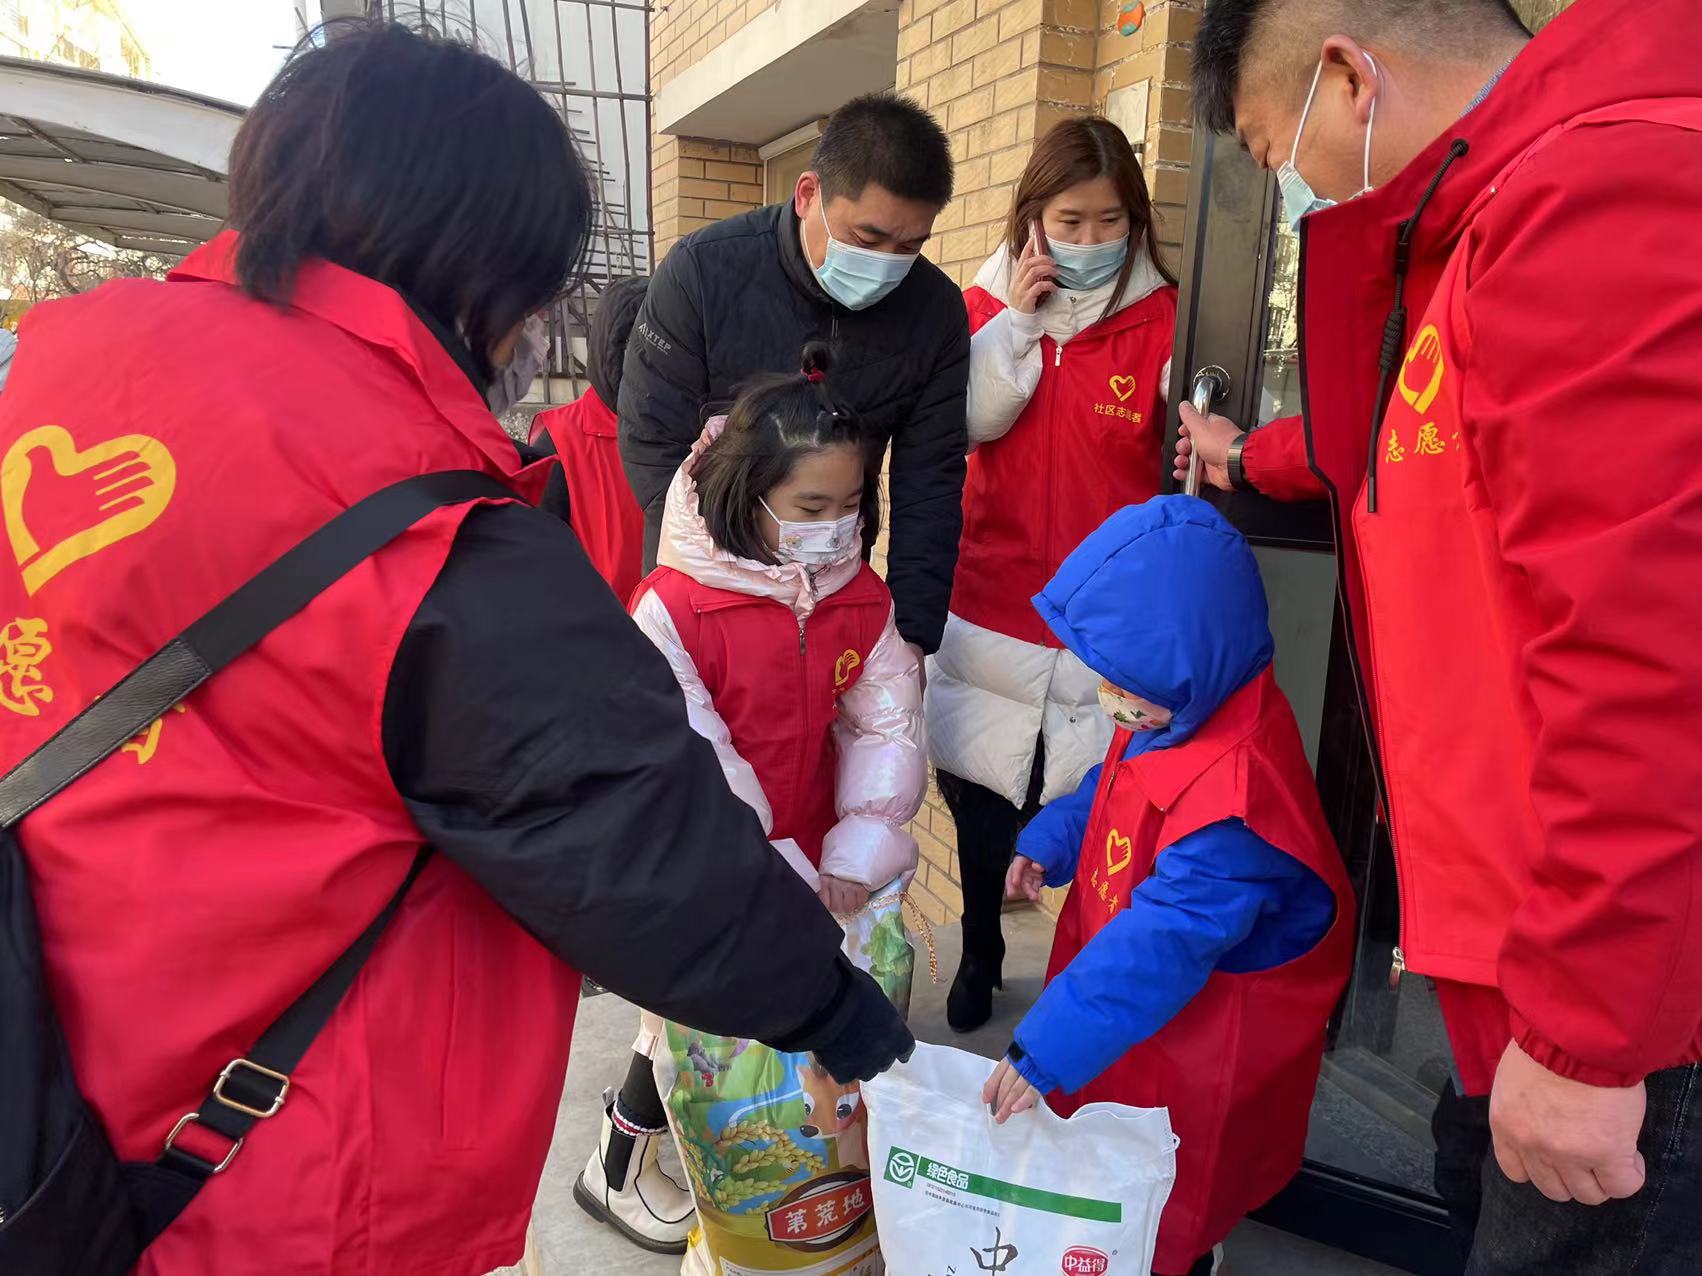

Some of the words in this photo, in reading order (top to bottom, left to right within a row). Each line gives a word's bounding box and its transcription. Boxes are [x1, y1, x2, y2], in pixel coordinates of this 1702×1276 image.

[1386, 421, 1461, 464] 志愿
[926, 1162, 969, 1190] 绿色食品
[1064, 1255, 1106, 1273] 中益得
